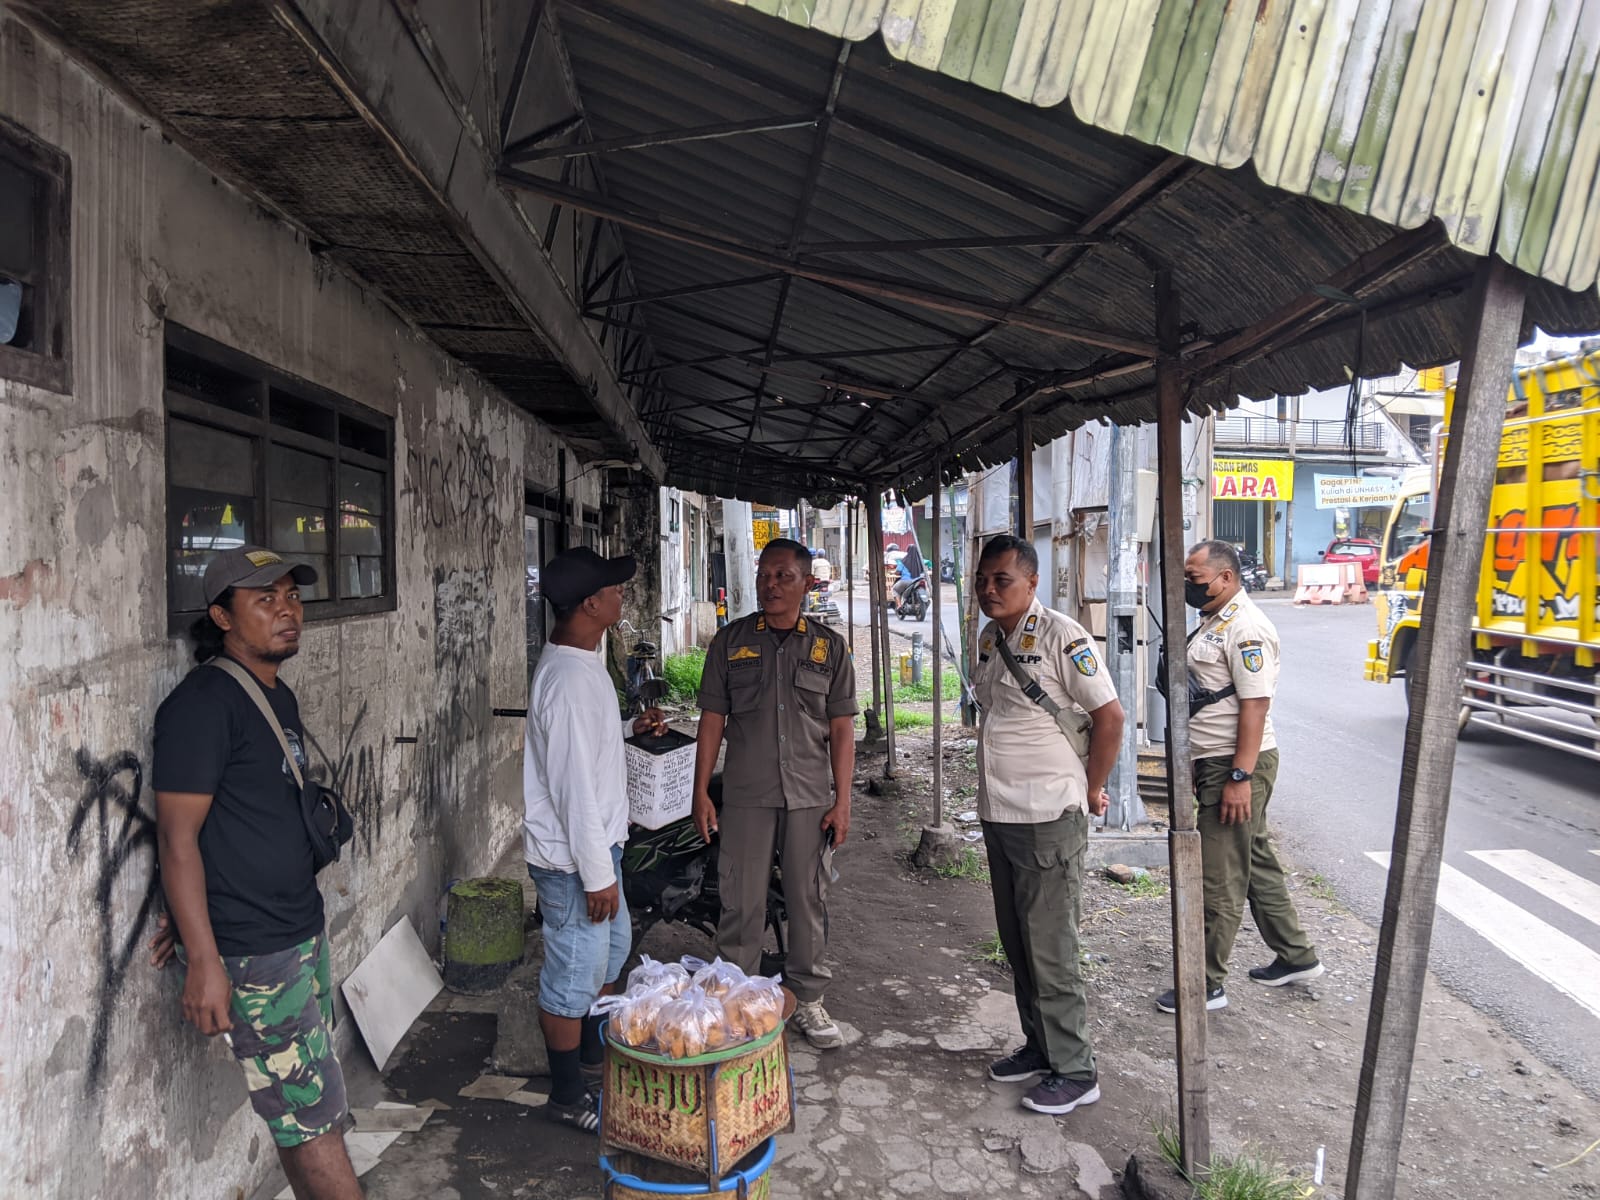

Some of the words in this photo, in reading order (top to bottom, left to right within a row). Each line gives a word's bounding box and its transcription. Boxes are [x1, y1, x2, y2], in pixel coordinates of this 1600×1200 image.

[1236, 462, 1258, 473] EMAS
[1320, 478, 1343, 488] Gagal
[1320, 487, 1345, 495] Kuliah
[1321, 496, 1351, 504] Prestasi
[1359, 494, 1388, 503] Kerjaan
[1203, 633, 1224, 644] POLPP
[611, 1056, 703, 1115] TAHU
